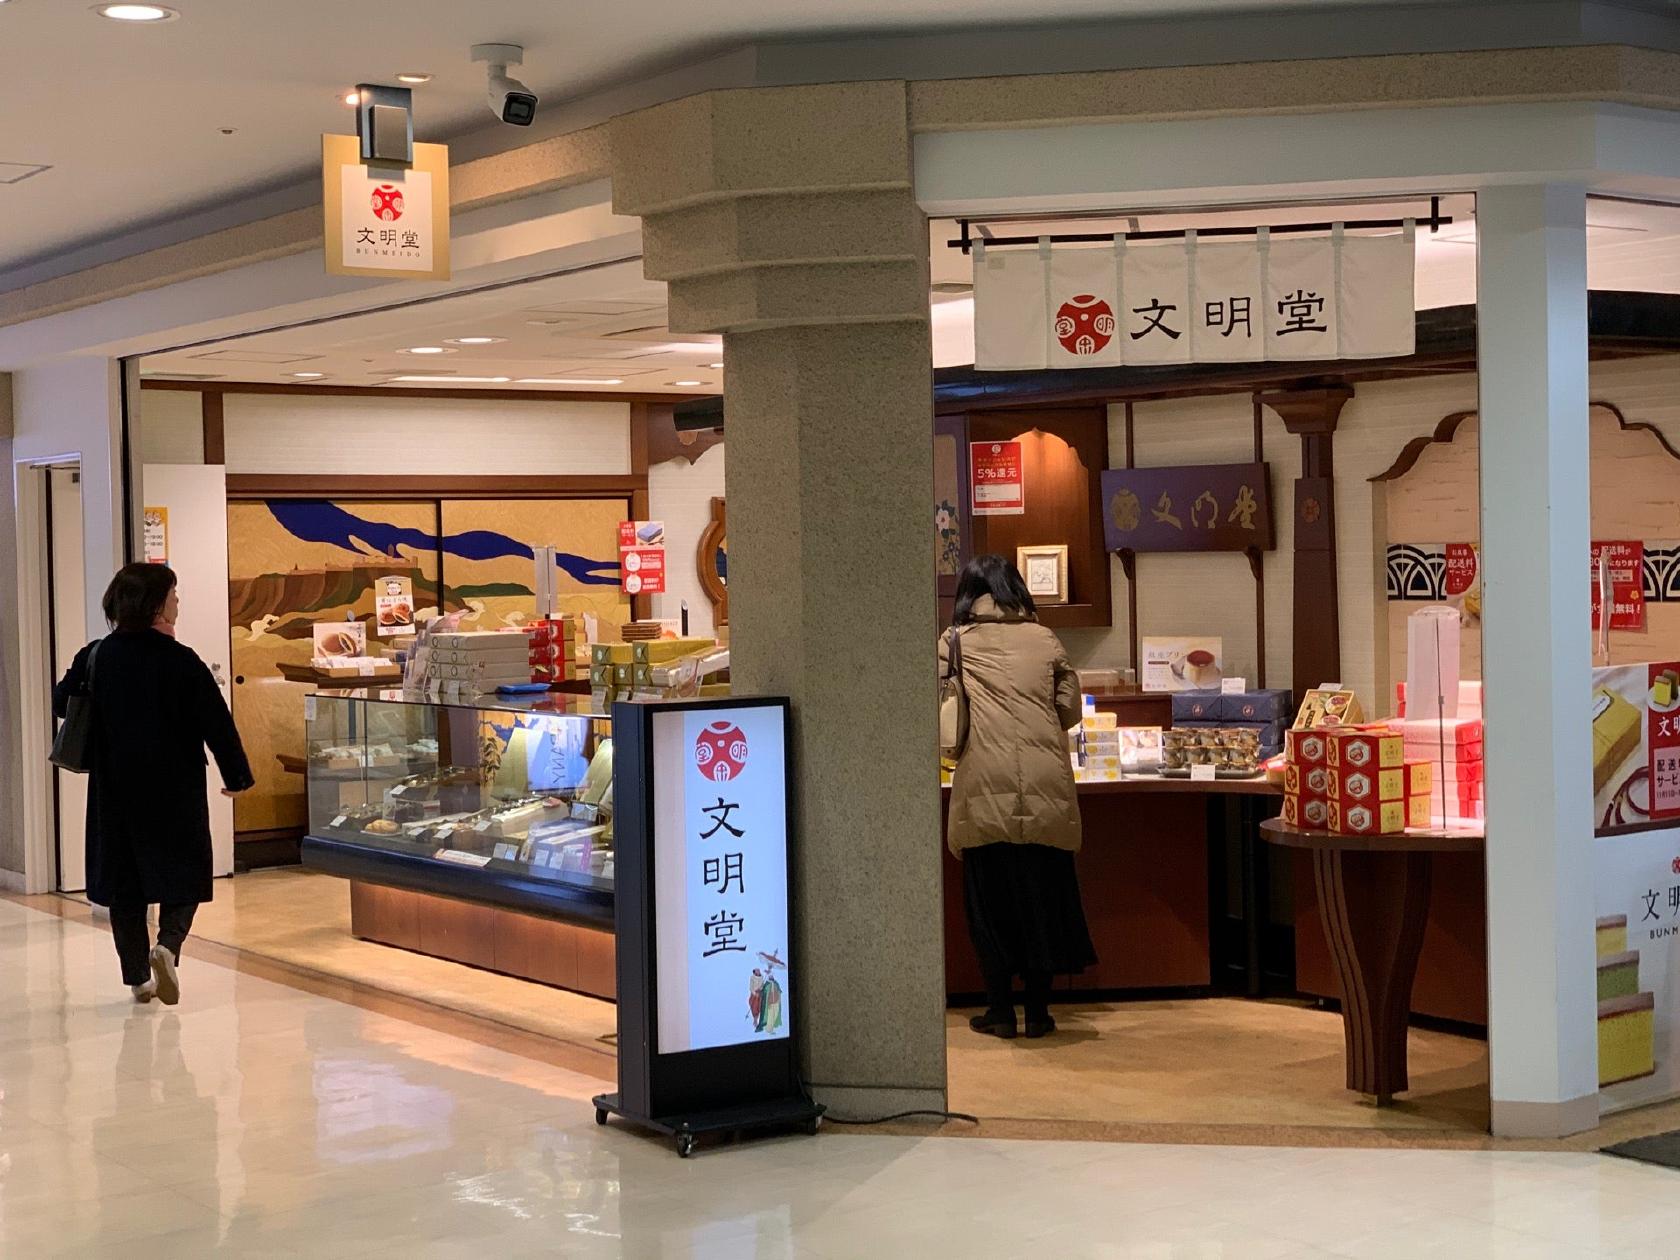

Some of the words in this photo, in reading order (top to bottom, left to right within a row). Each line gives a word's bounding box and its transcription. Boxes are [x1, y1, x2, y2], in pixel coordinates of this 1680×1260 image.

[356, 227, 420, 249] 文明堂
[356, 248, 420, 258] BUNMEIDO
[1130, 289, 1328, 340] 文明堂
[977, 467, 1017, 479] 5%還元
[1656, 758, 1680, 772] 配送
[1656, 773, 1680, 788] サービ
[699, 797, 747, 958] 文明堂
